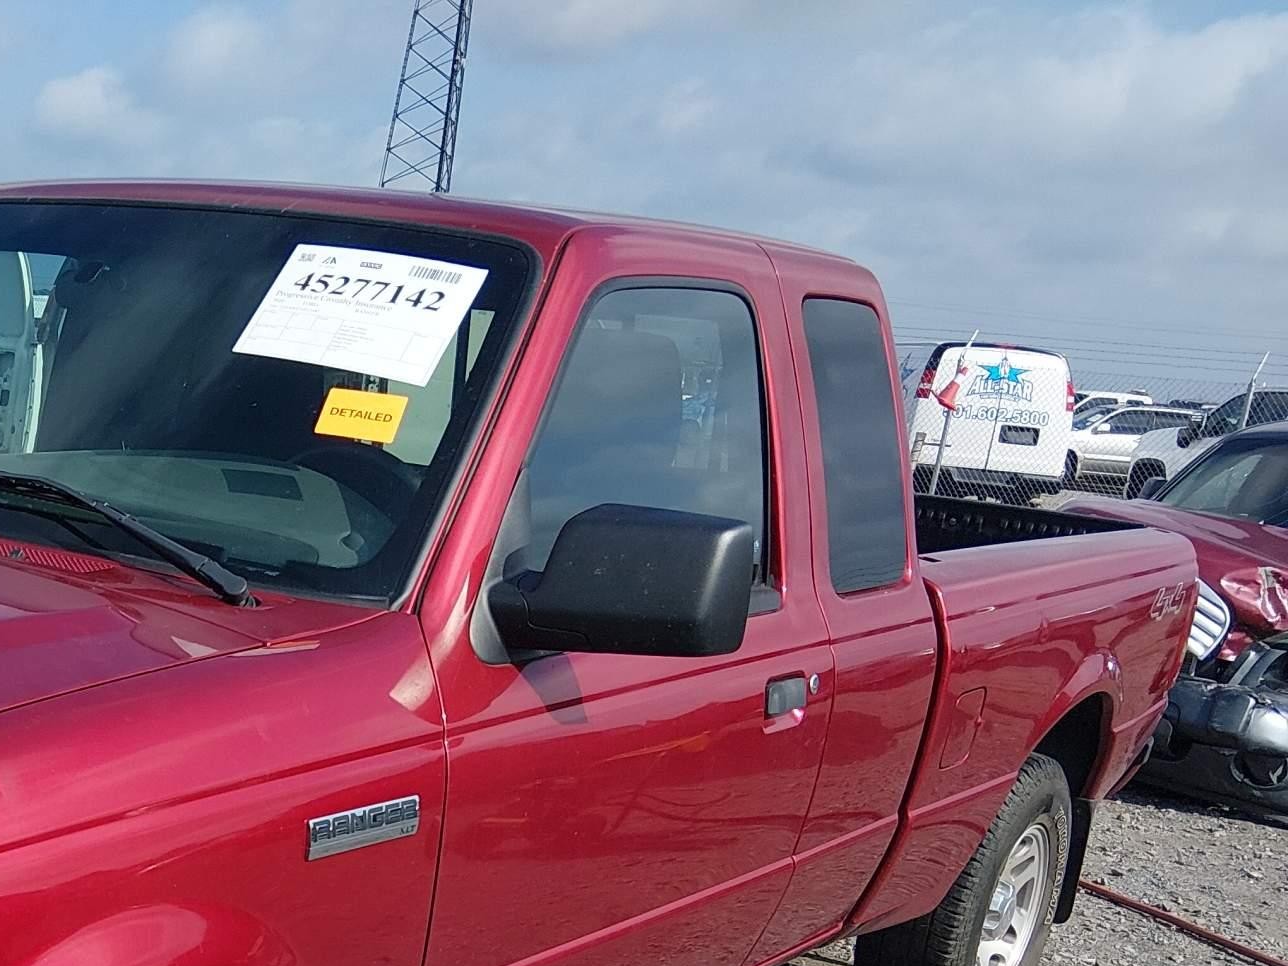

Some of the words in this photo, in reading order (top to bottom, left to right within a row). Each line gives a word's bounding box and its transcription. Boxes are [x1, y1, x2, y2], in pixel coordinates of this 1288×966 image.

[294, 272, 446, 312] 45277142
[329, 407, 393, 423] DETAILED
[942, 403, 1050, 427] 01.602.5800
[312, 798, 418, 842] RANGER
